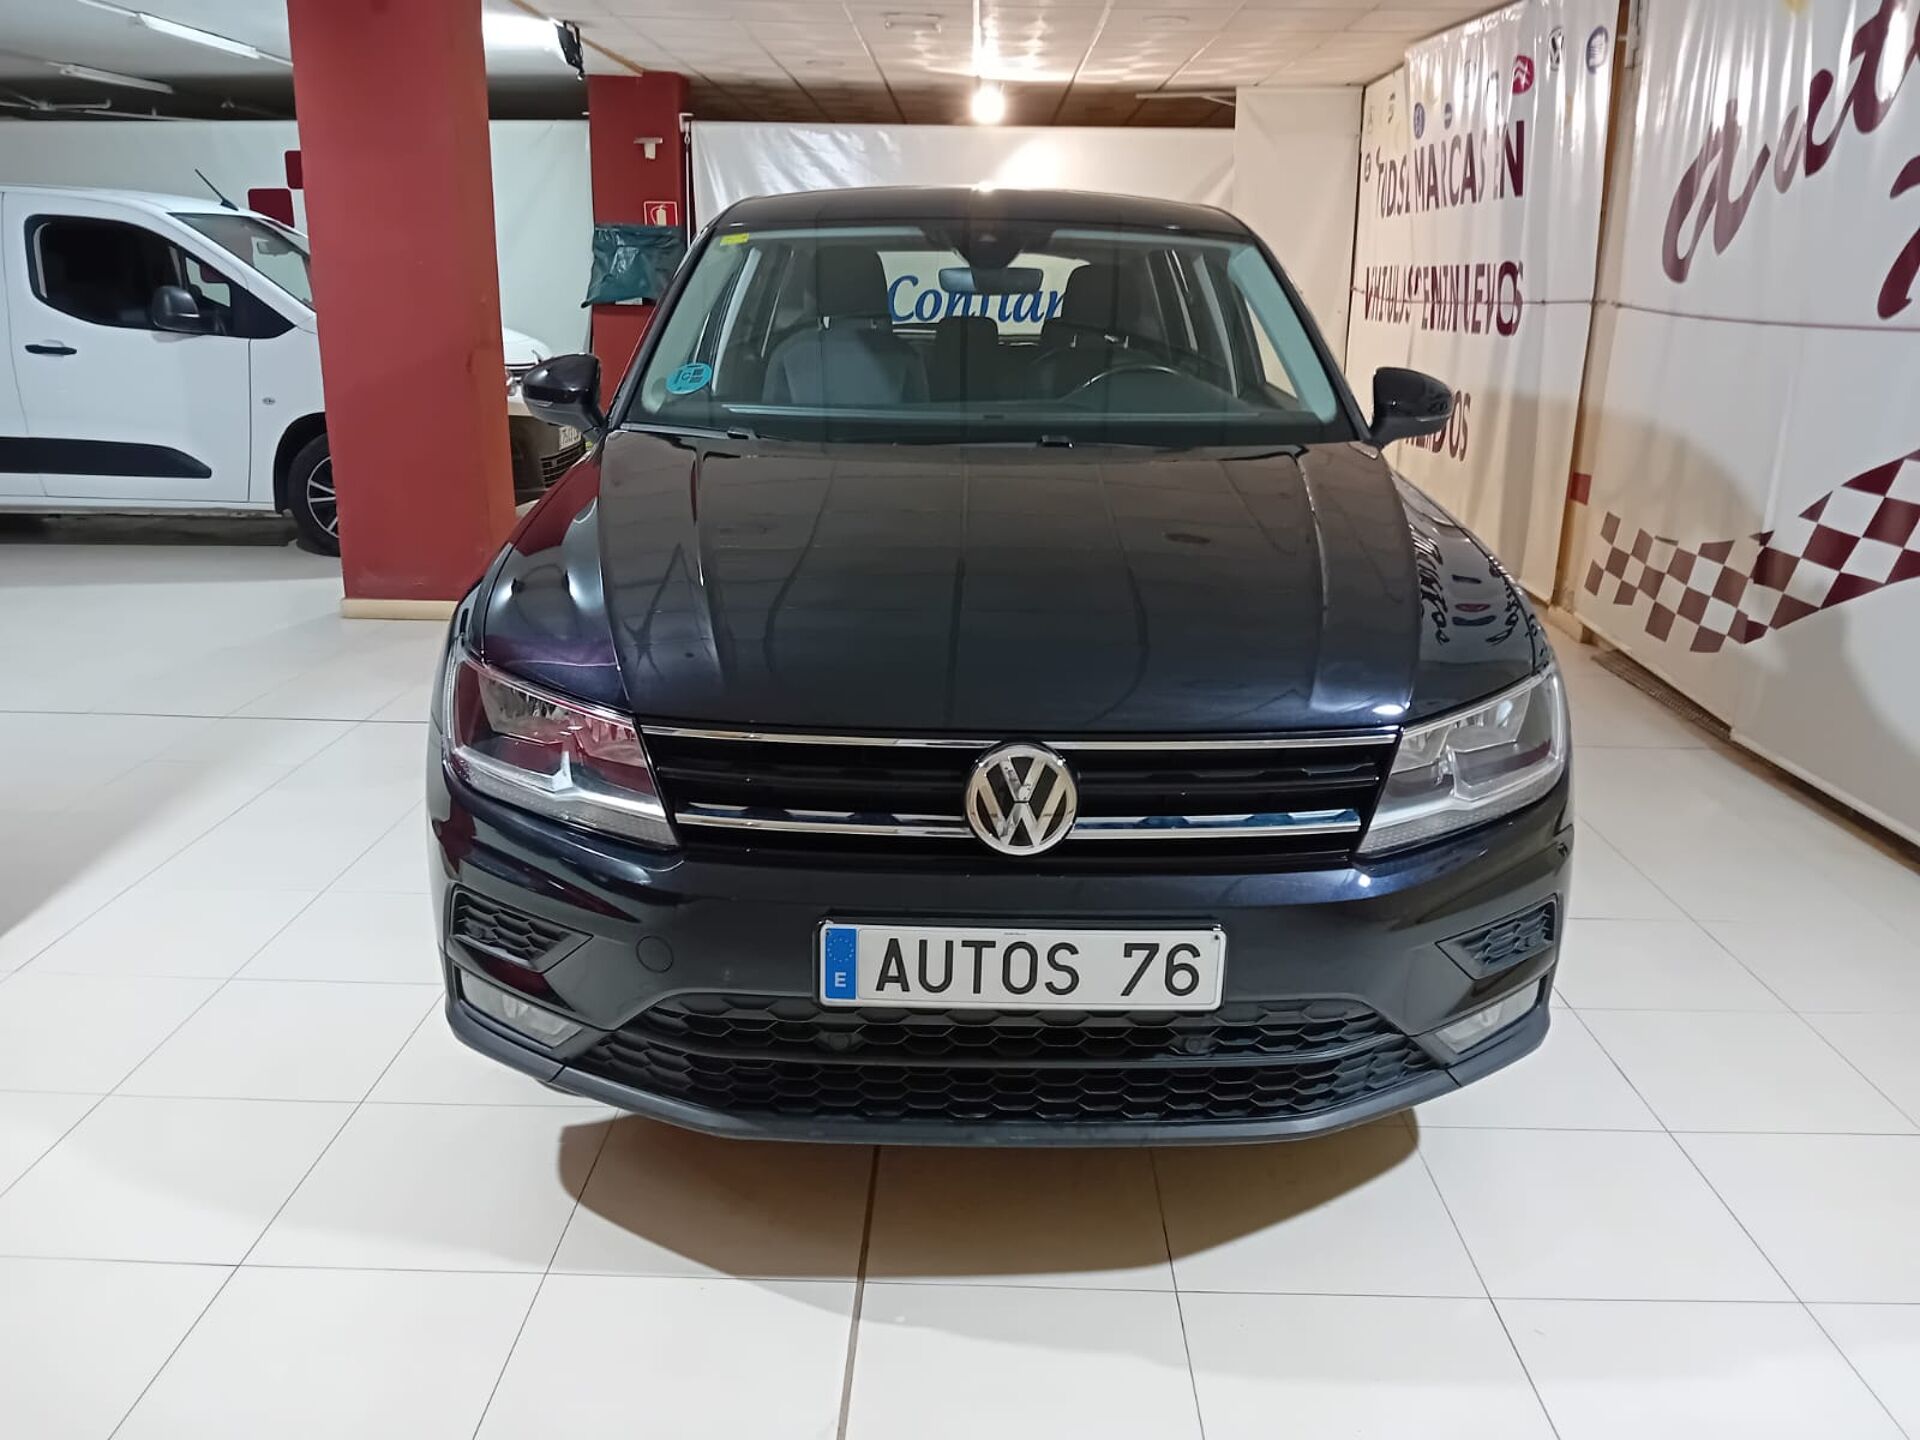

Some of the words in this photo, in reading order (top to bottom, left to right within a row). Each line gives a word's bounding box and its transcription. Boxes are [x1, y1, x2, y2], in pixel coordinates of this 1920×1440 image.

[834, 971, 847, 988] E
[875, 937, 1080, 996] AUTOS
[1120, 942, 1201, 997] 76
